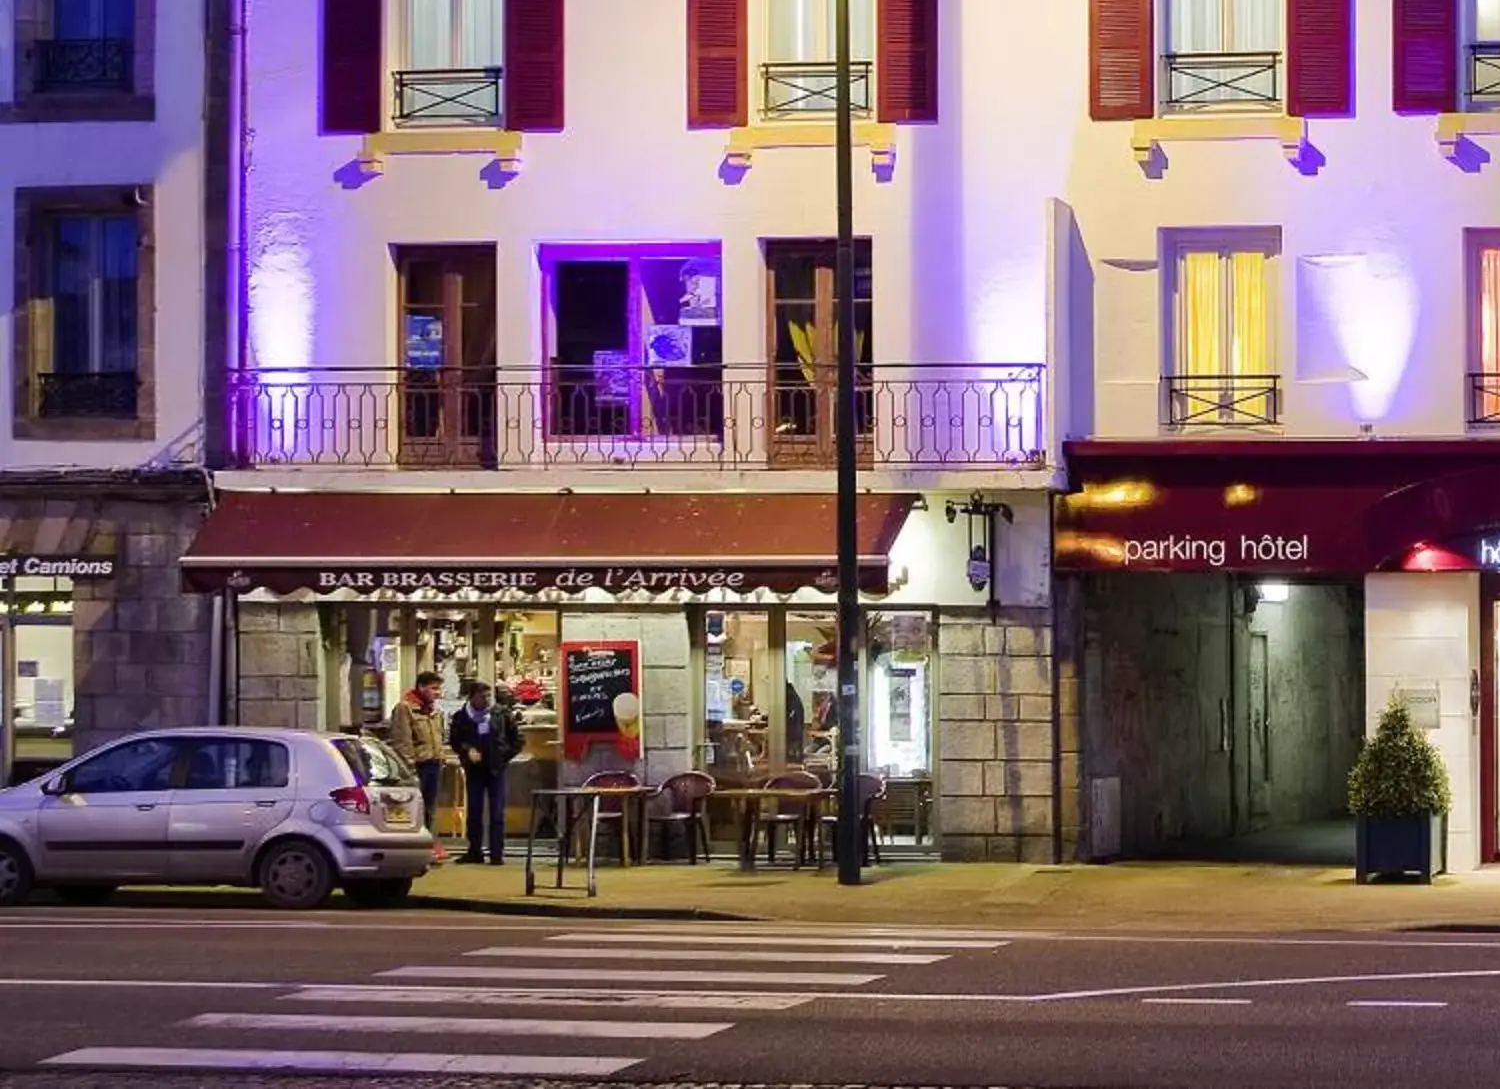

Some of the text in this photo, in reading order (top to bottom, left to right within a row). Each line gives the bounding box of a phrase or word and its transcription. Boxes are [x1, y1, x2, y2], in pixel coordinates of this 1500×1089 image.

[1124, 534, 1308, 566] parking hôtel
[24, 557, 113, 574] Camions
[319, 568, 745, 587] BAR BRASSERIE de l'Arrivée
